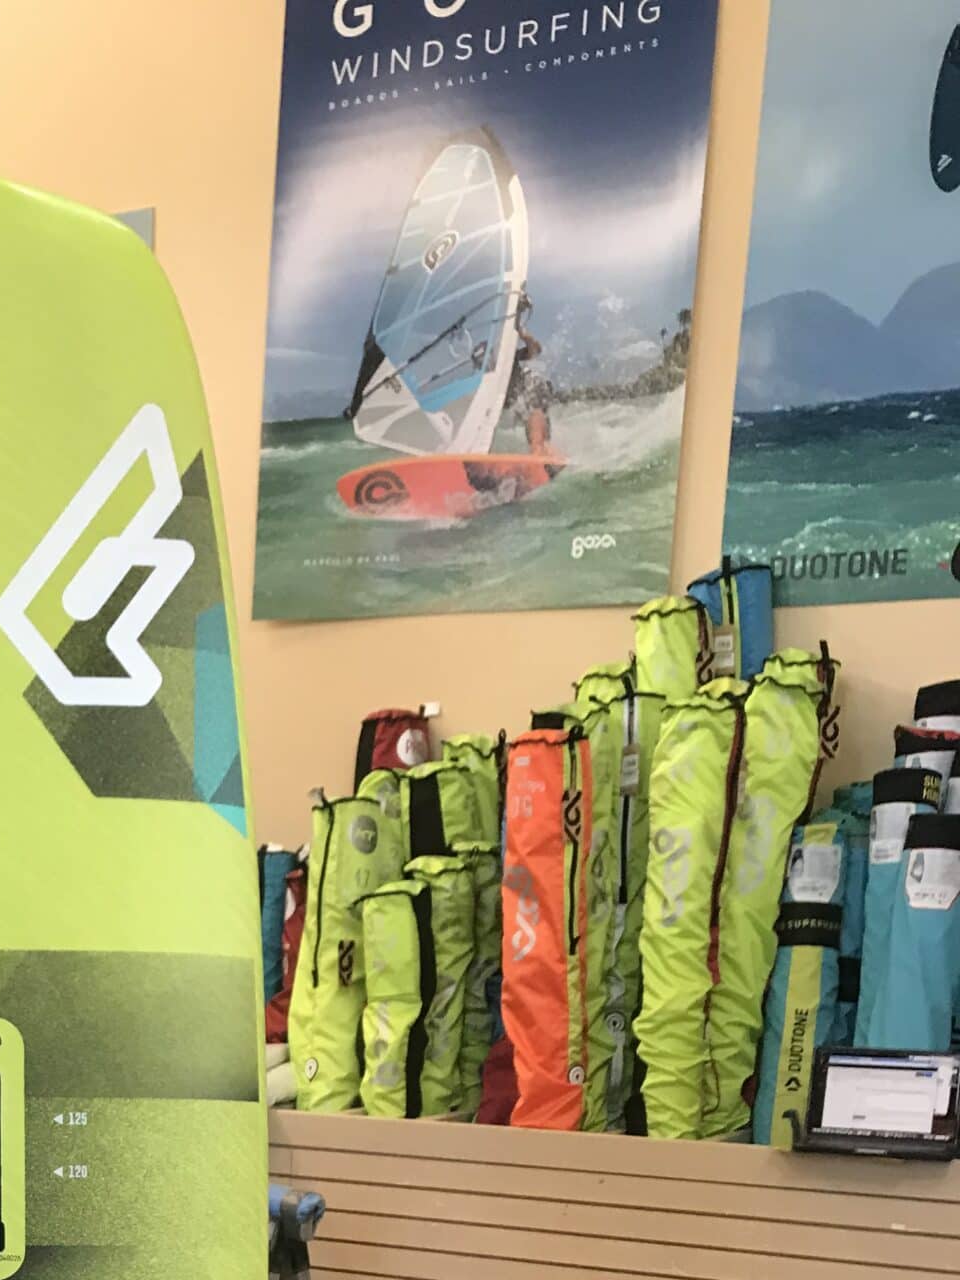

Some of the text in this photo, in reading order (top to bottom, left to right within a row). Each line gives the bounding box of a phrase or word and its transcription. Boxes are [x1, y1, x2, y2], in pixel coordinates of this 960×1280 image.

[332, 0, 661, 86] WINDSURFING
[328, 38, 659, 110] BOARDS SAILS COMPONENTS
[771, 549, 909, 581] DUOTONE
[788, 1008, 810, 1073] DUOTONE
[68, 1113, 87, 1125] 125
[68, 1165, 87, 1178] 120
